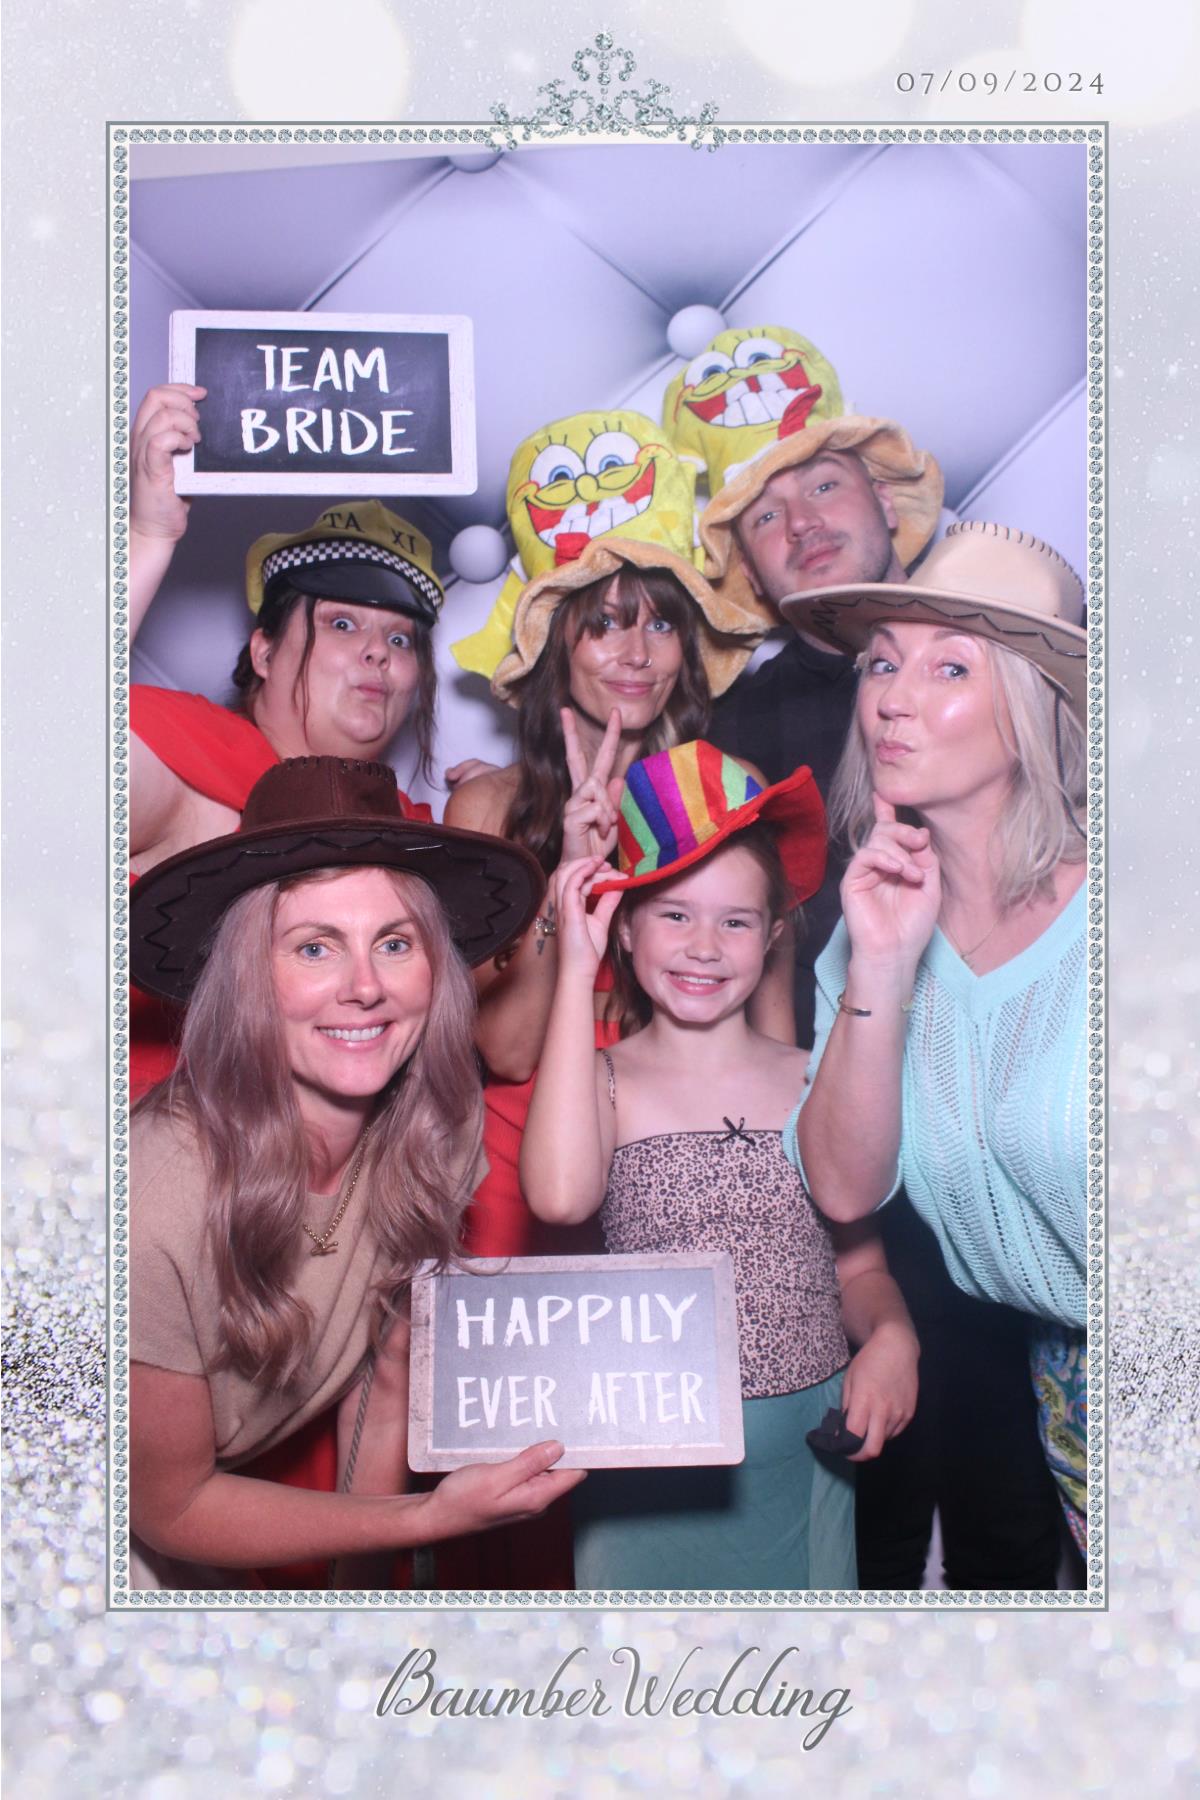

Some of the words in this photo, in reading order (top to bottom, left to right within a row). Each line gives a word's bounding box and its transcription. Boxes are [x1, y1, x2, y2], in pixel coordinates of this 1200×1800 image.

[257, 344, 389, 394] TEAM
[241, 408, 415, 455] BRIDE
[456, 1293, 698, 1349] HAPPILY
[456, 1375, 560, 1429] EVER
[587, 1371, 707, 1426] AFTER
